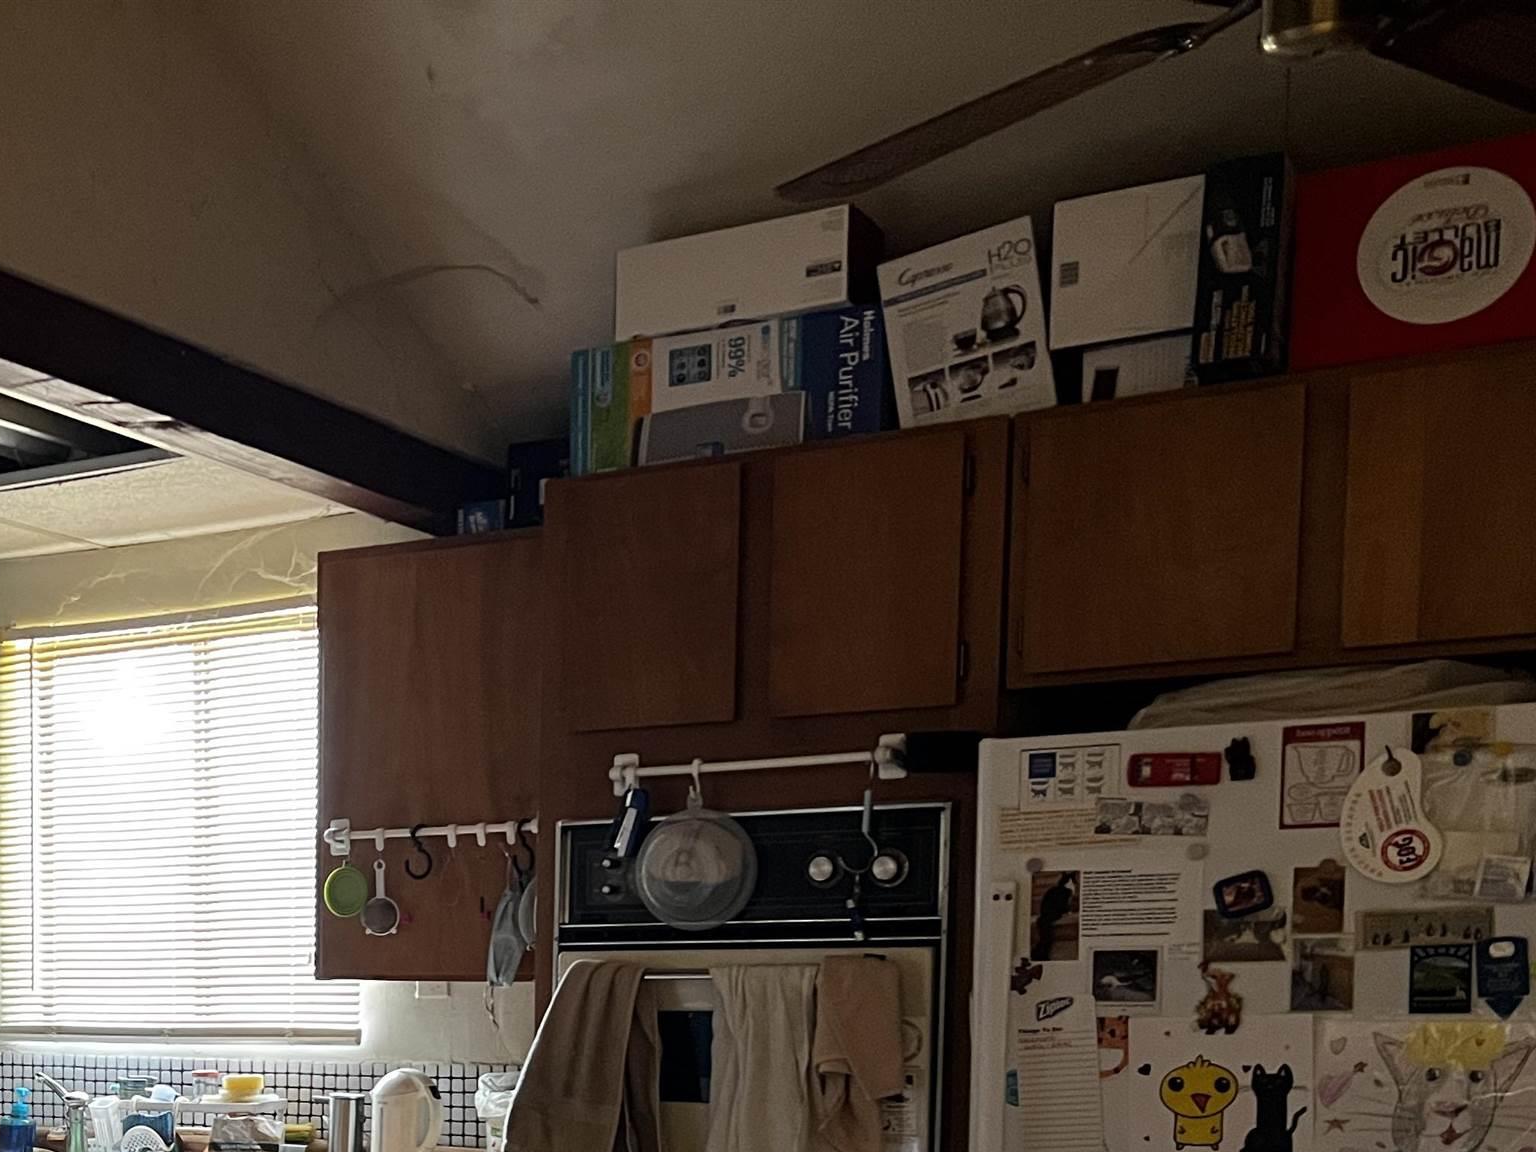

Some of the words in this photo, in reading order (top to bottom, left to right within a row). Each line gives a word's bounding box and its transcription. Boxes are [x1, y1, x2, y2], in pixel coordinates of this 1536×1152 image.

[988, 238, 1033, 265] H2O
[838, 315, 861, 346] Air
[863, 310, 876, 361] Holmes
[728, 337, 746, 378] 99%
[838, 351, 861, 430] Purifier
[1393, 836, 1418, 865] FOG
